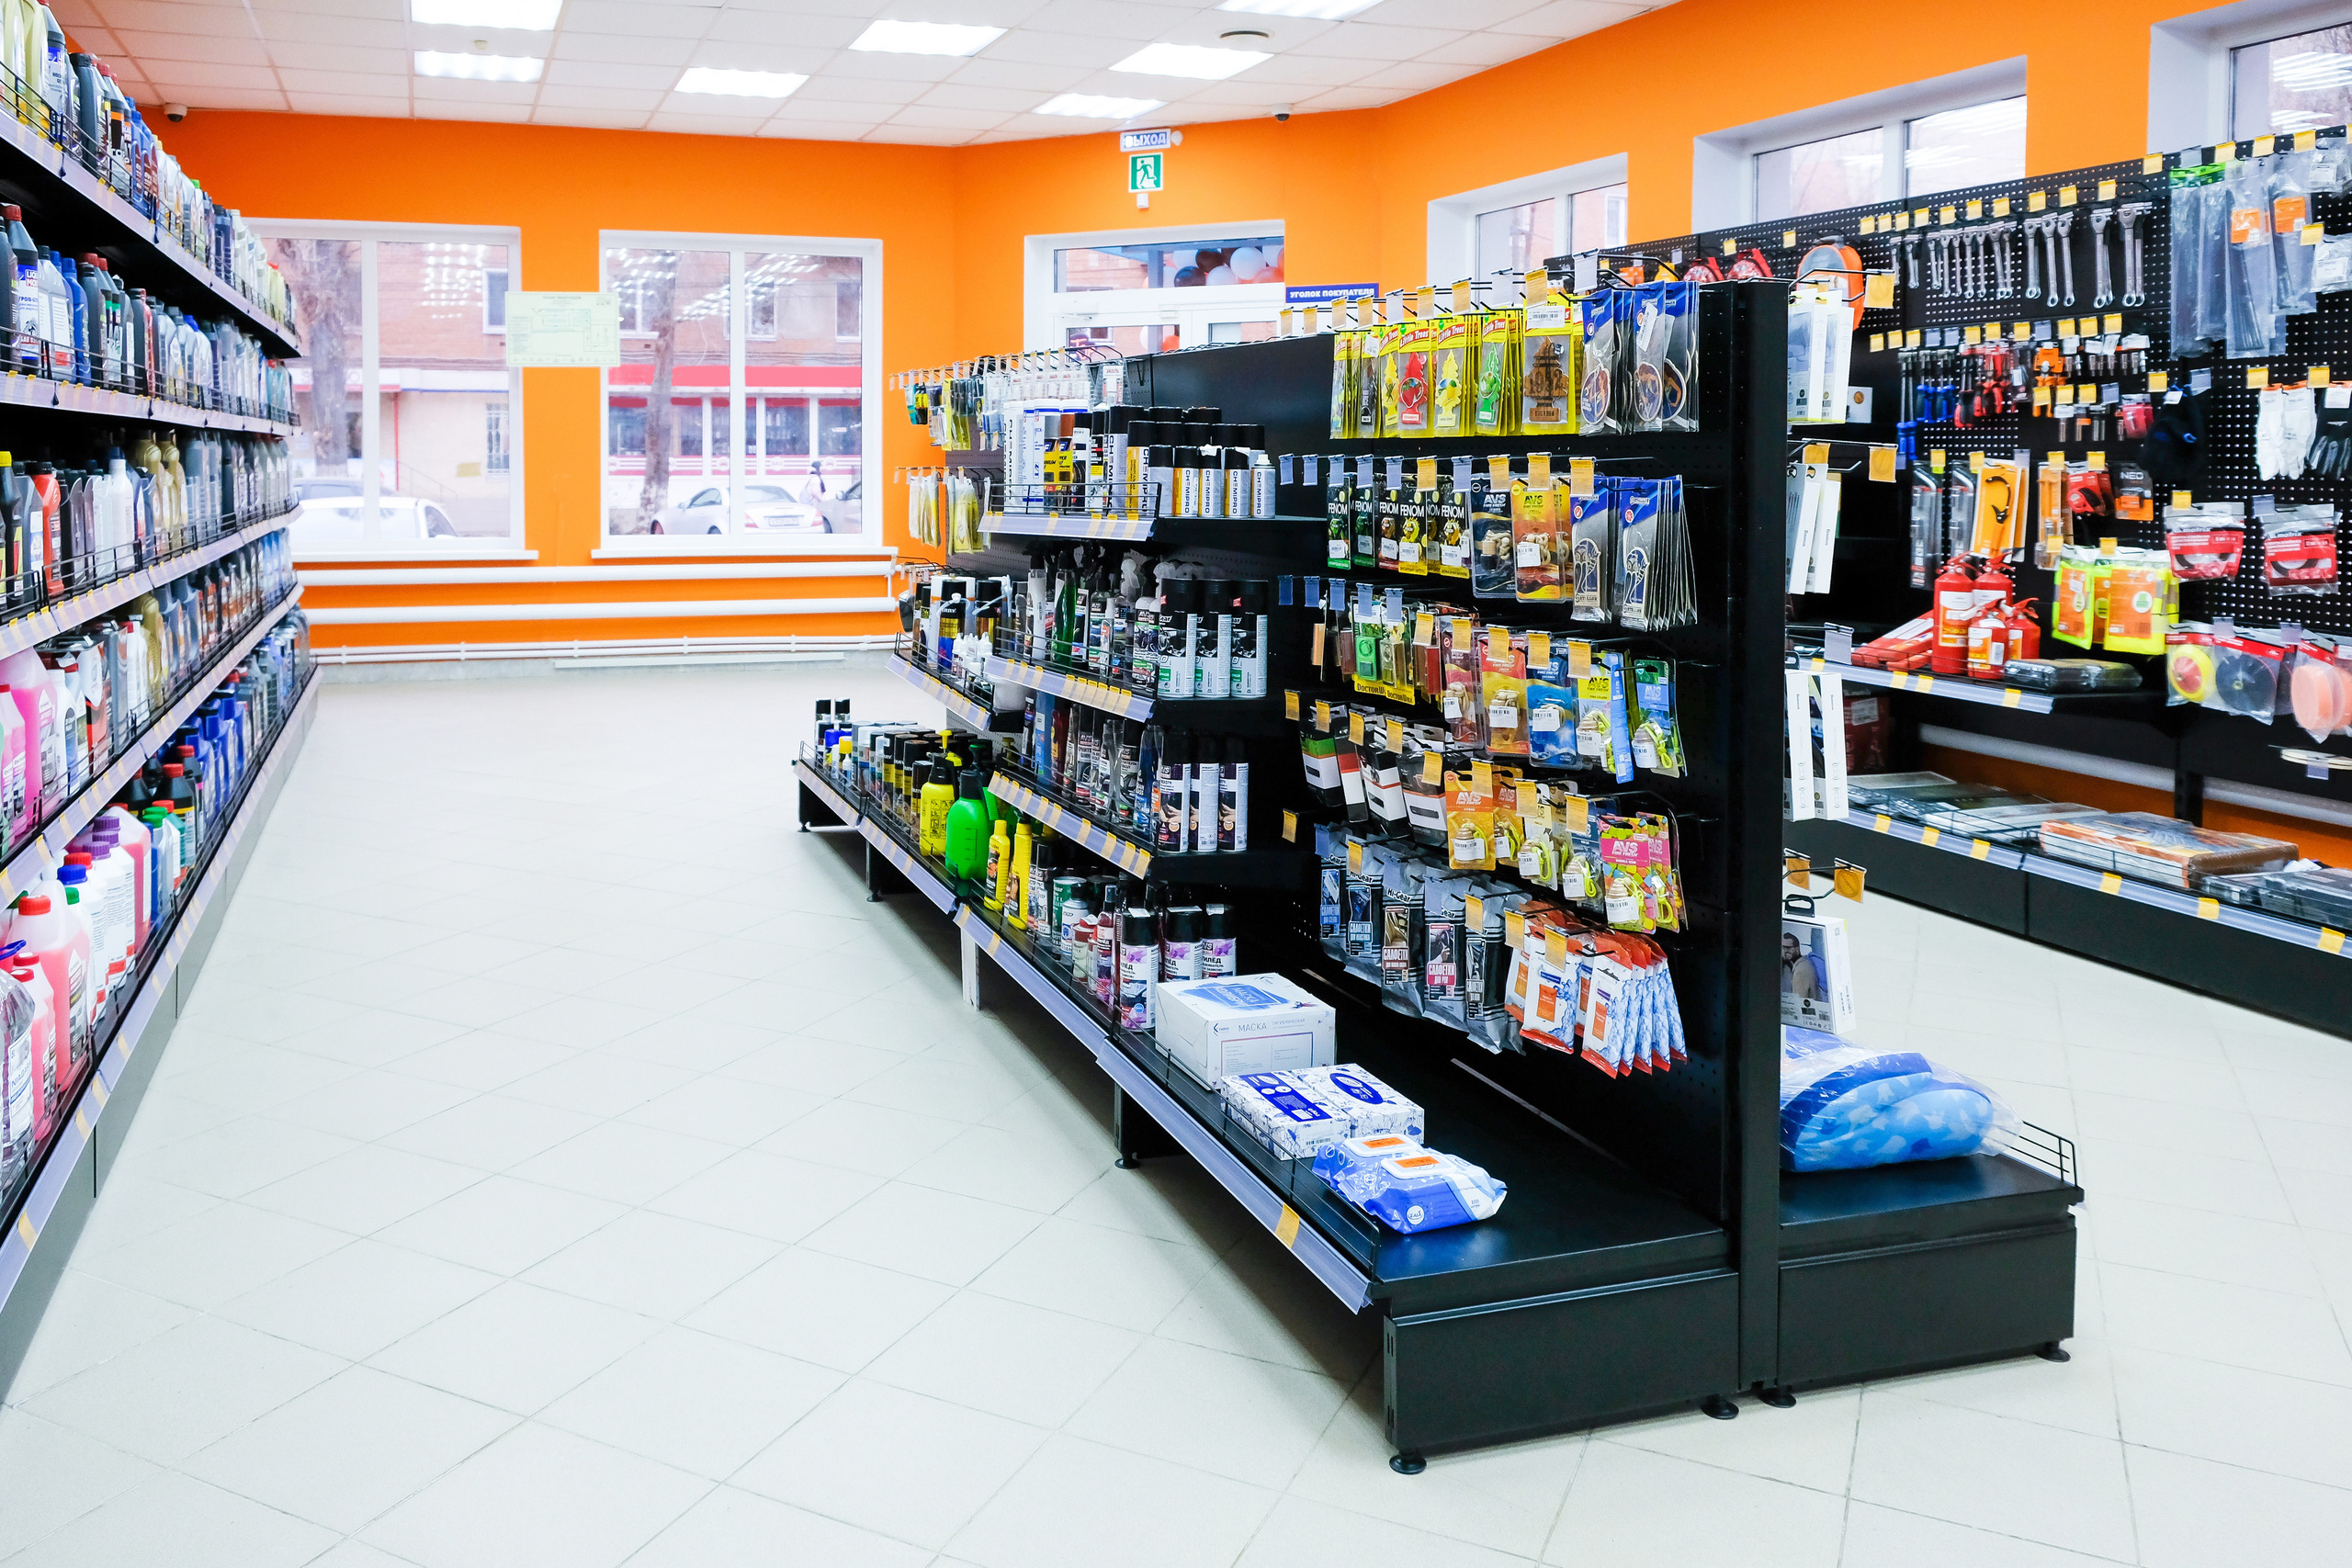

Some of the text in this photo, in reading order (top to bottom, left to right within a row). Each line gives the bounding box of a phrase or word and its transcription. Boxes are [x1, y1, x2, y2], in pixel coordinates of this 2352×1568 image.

[1125, 133, 1166, 147] ВЫХОД
[1400, 330, 1428, 348] Little Trees
[1438, 326, 1464, 343] Little Trees
[1484, 494, 1506, 504] AVS
[1524, 496, 1543, 505] AVS
[1328, 504, 1347, 515] FENOM
[1355, 500, 1372, 513] FENOM
[1380, 502, 1399, 515] FENOM
[1400, 504, 1425, 518] FENOM
[1427, 505, 1441, 516] NOM
[1441, 505, 1464, 519] FENOM
[1588, 677, 1609, 688] AVS
[1456, 792, 1481, 802] AVS
[1612, 840, 1638, 853] AVS
[1388, 888, 1411, 904] Hi-Gear
[1429, 964, 1454, 976] САЛФЕТКИ
[1238, 1023, 1267, 1032] МАСКА
